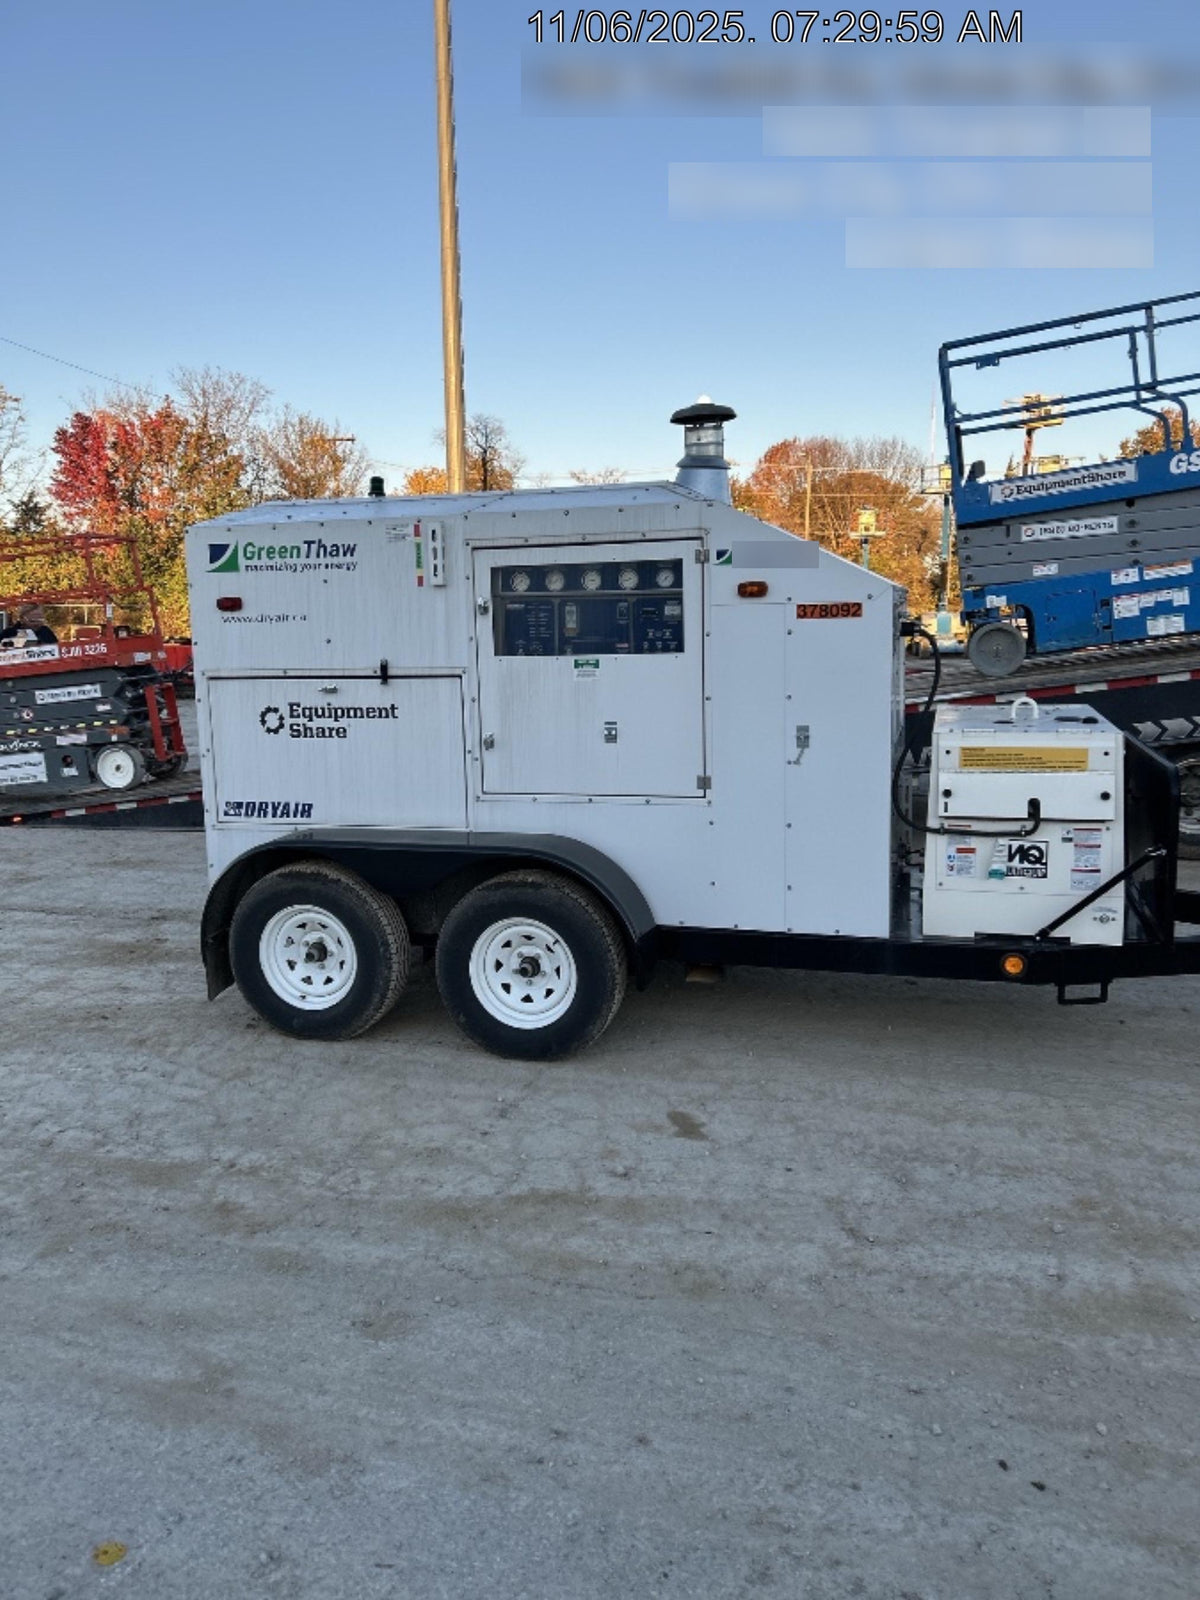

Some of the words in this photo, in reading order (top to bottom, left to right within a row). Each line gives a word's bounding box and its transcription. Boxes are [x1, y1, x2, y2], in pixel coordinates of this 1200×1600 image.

[1015, 469, 1127, 495] EquipmentShare
[797, 602, 863, 619] 378092
[288, 702, 399, 722] Equipment
[289, 723, 348, 738] Share
[243, 801, 314, 819] DRYAIR
